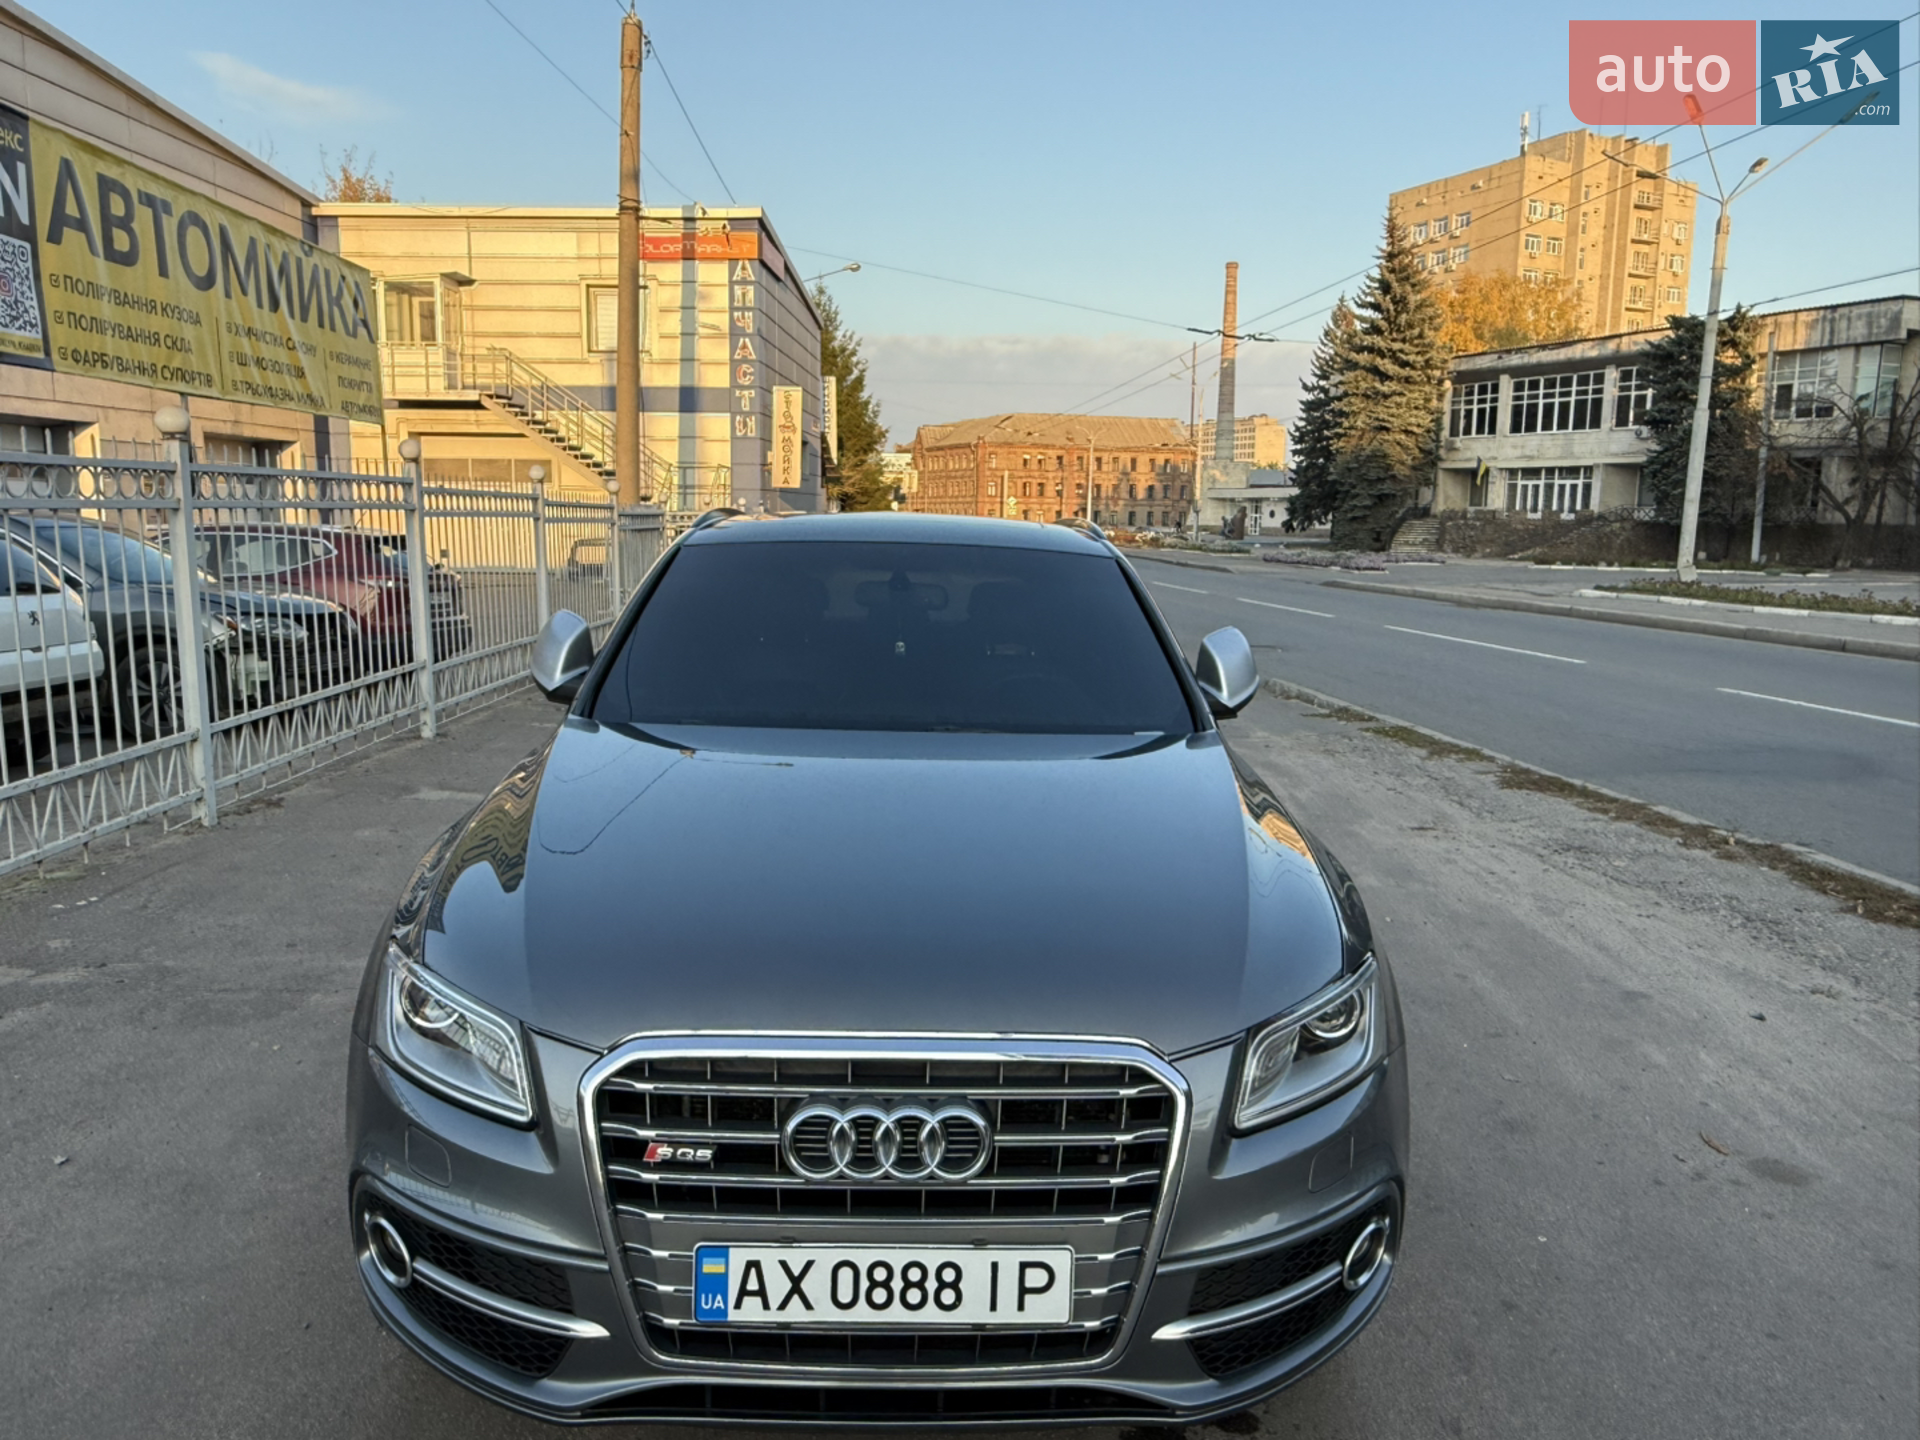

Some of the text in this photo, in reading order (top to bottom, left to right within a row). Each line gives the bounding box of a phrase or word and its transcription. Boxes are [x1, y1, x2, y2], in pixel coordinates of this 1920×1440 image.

[46, 156, 375, 344] АВТОМИЙКА
[63, 274, 203, 328] ПОЛІРУВАННЯ КУЗОВА
[67, 311, 161, 348] ПОЛІРУВАННЯ
[163, 333, 193, 355] СКЛА
[71, 348, 213, 388] ФАРБУВАННЯ СУПОРТІВ
[701, 1293, 725, 1310] UA
[733, 1259, 1056, 1312] AX 0888 IP
